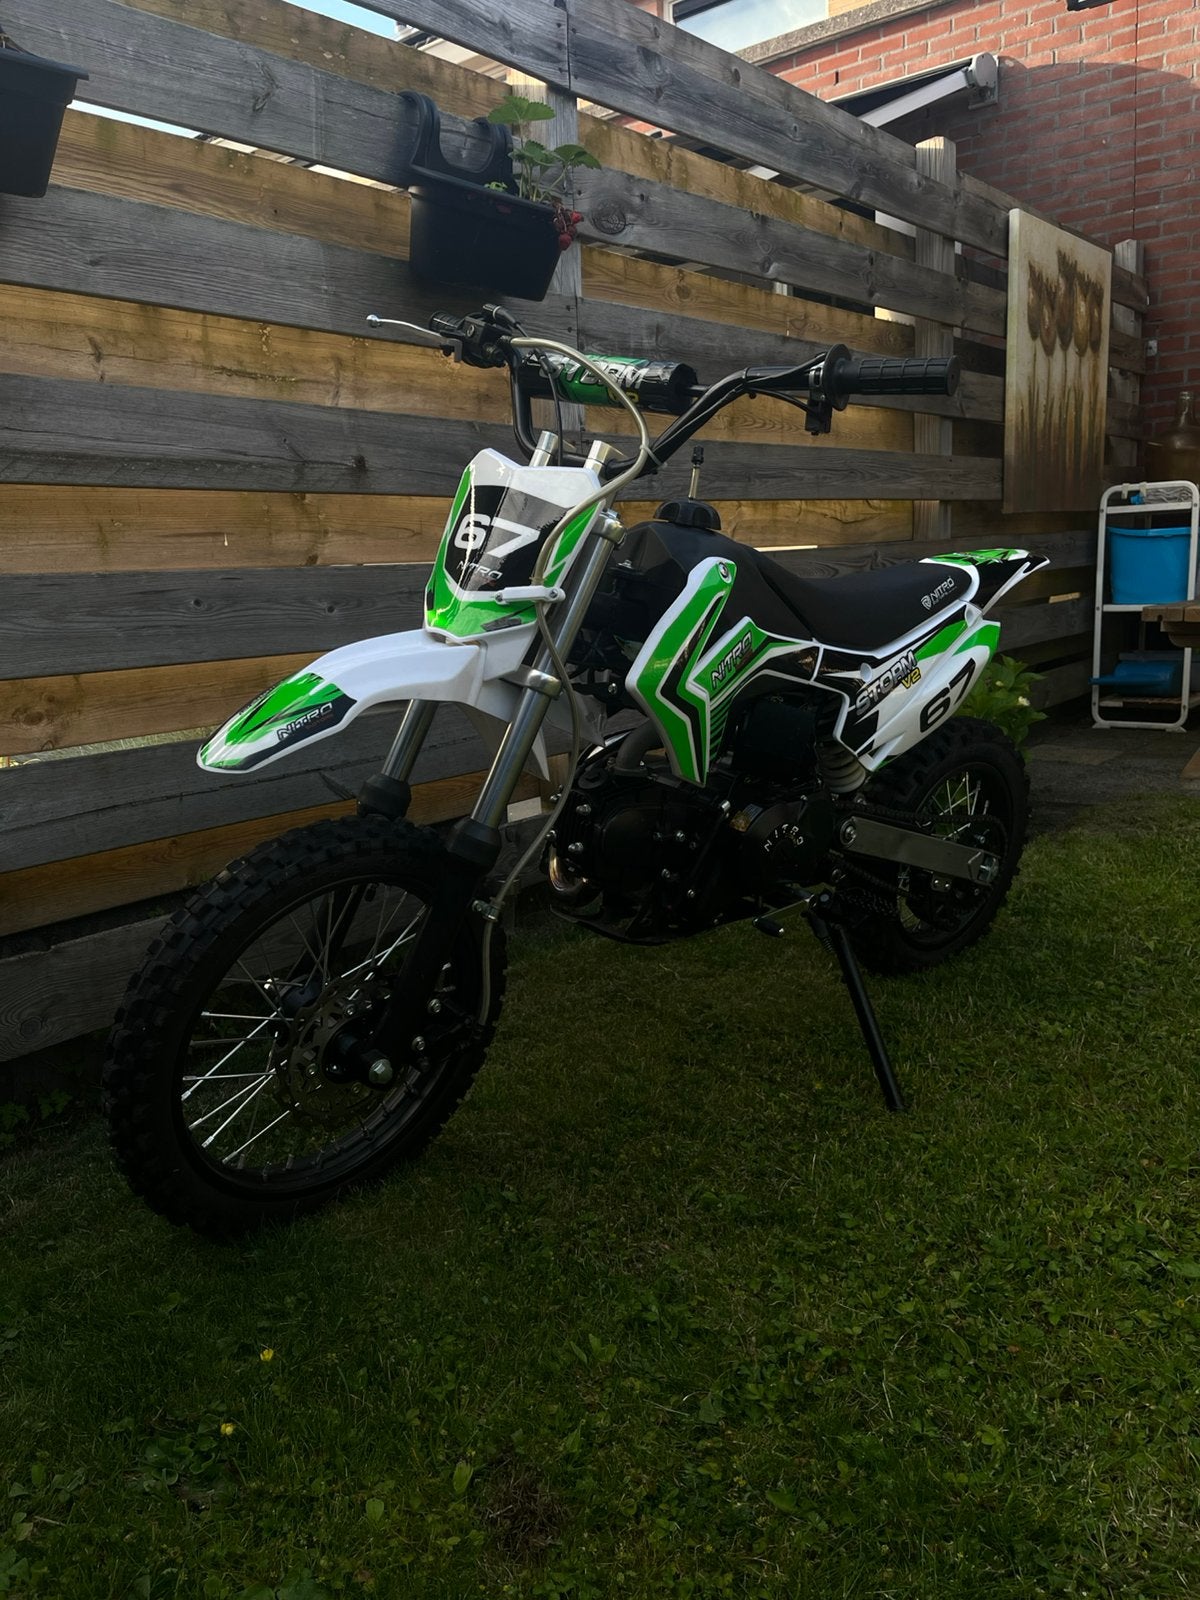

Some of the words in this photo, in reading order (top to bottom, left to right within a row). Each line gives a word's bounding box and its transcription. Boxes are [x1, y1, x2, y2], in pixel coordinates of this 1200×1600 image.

[454, 513, 541, 558] 67
[930, 577, 955, 602] NITRO
[711, 630, 752, 689] NITRO
[901, 667, 922, 689] V2
[855, 649, 918, 716] STORM
[919, 658, 976, 733] 67
[277, 702, 333, 740] NITRO
[764, 824, 804, 852] NITRO
